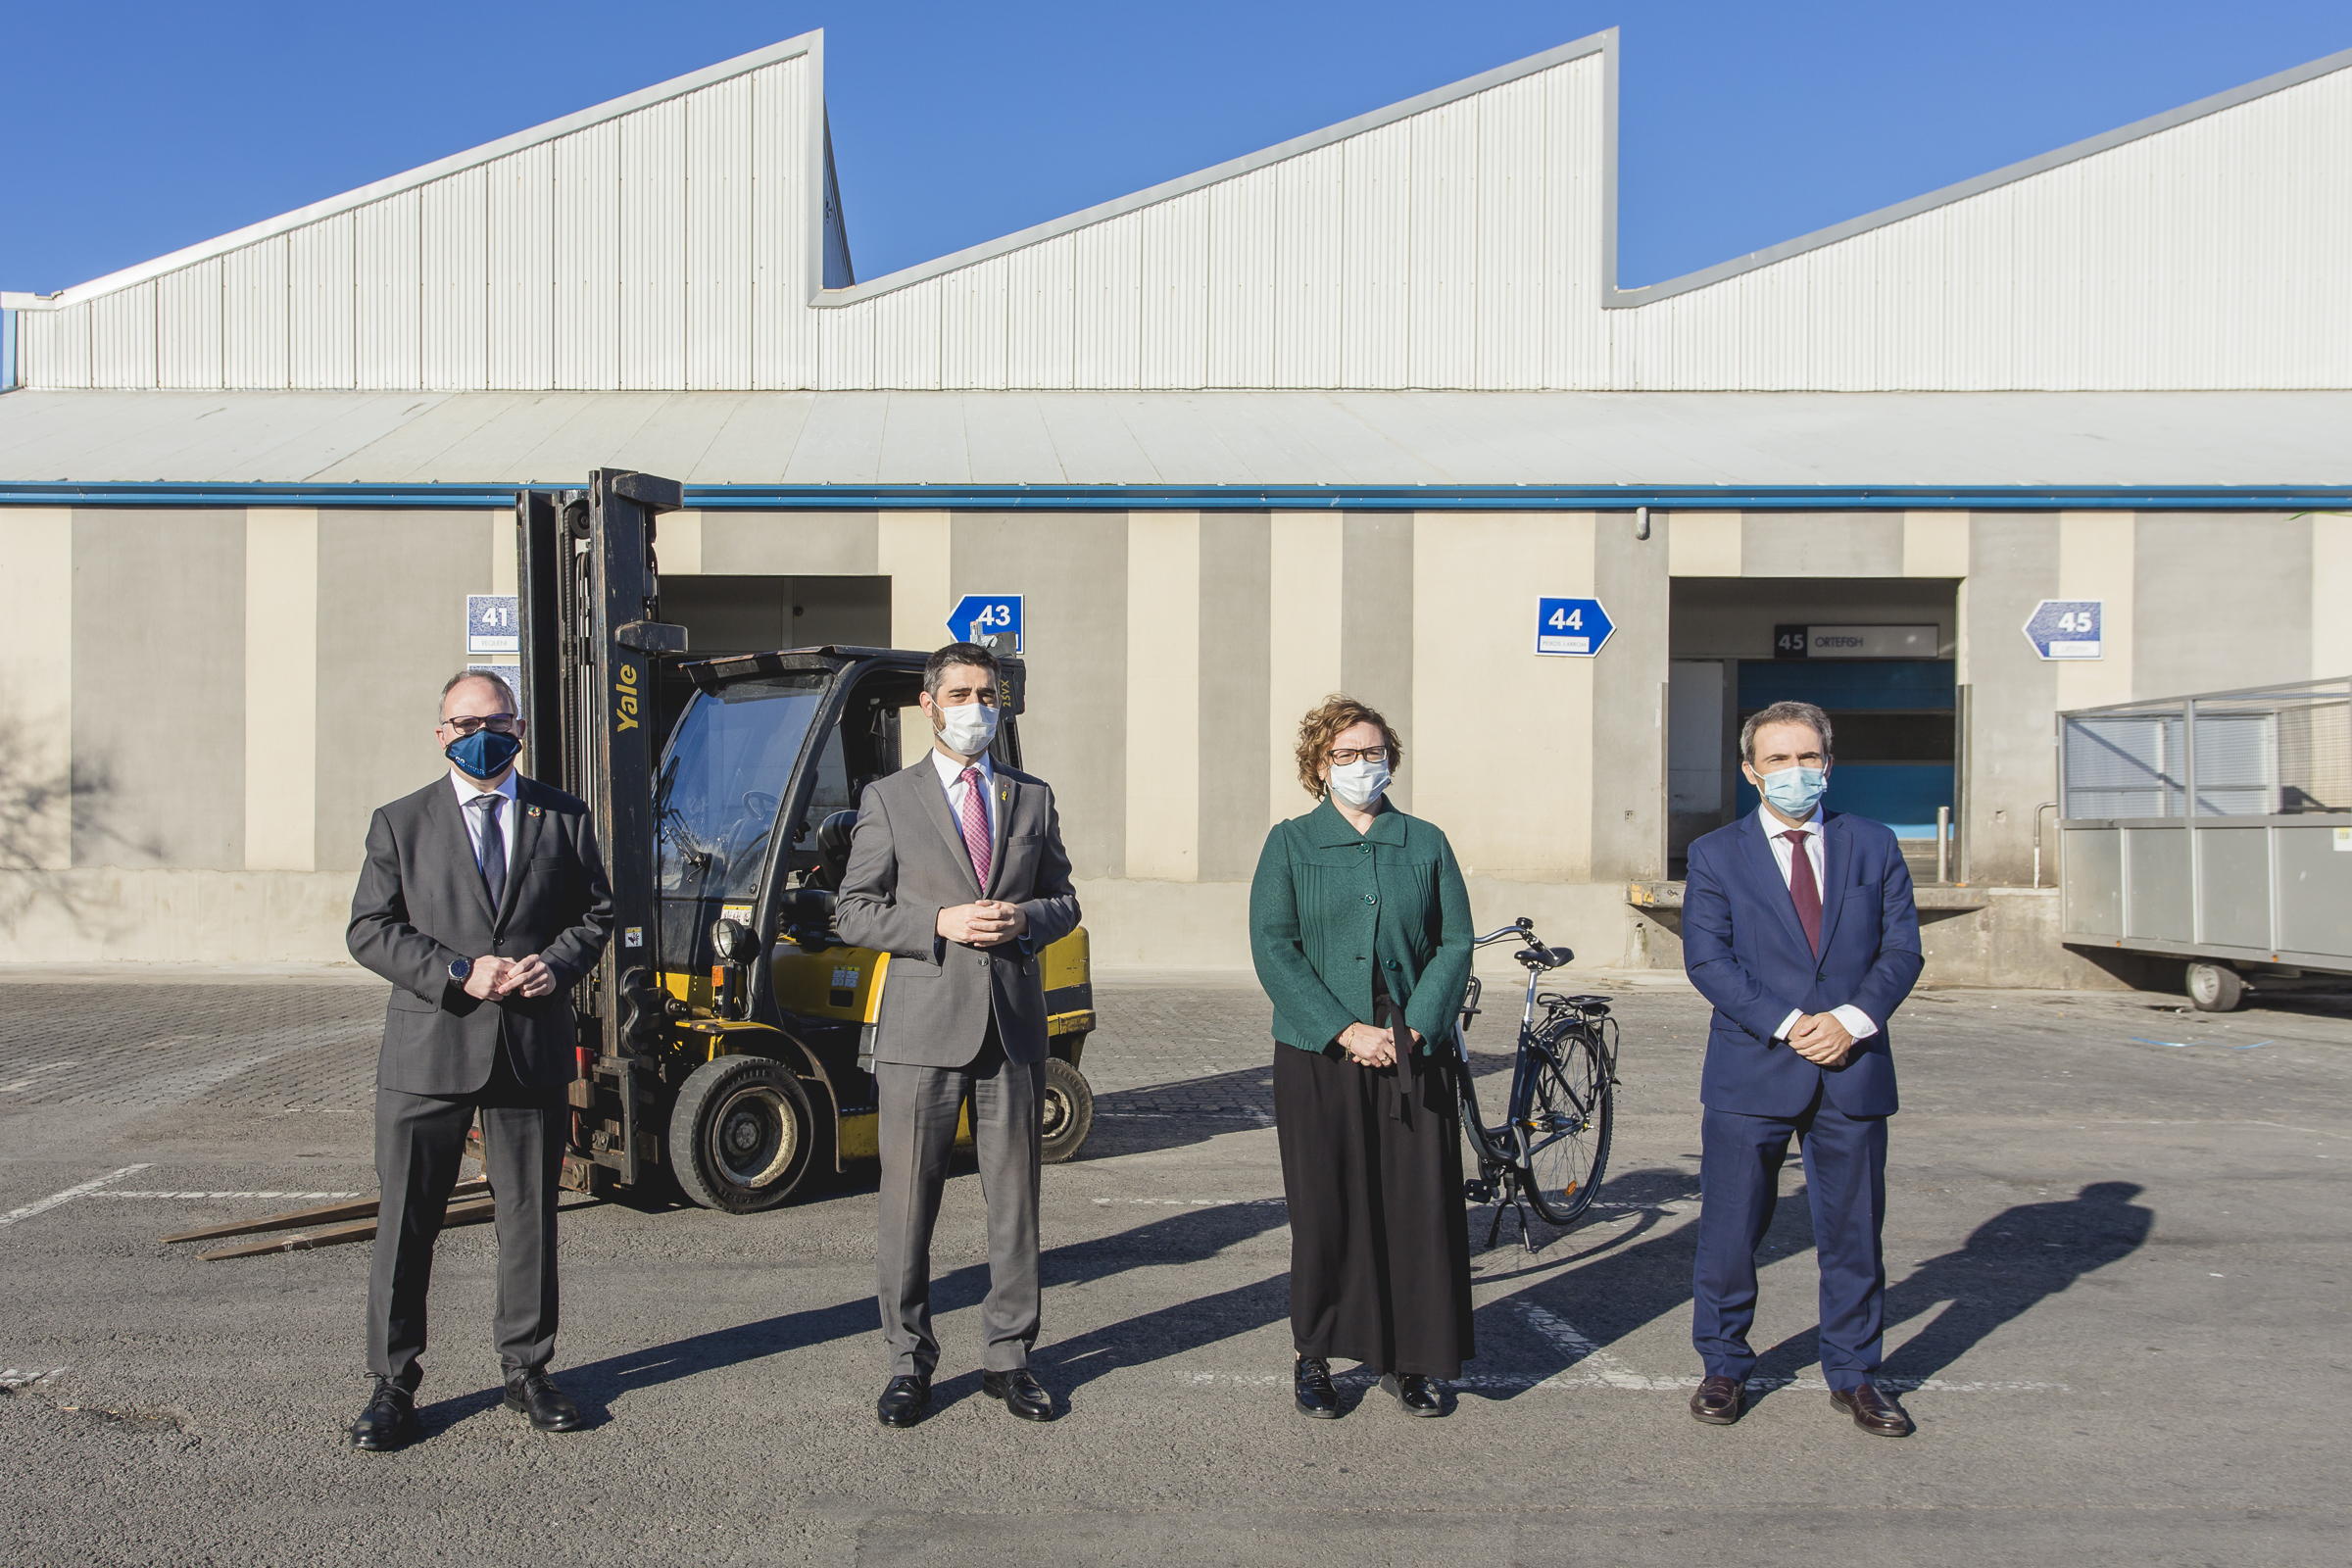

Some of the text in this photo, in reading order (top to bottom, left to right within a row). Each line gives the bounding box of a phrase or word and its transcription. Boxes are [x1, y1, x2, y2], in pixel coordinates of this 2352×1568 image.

[481, 607, 508, 627] 41
[977, 604, 1011, 626] 43
[1548, 608, 1584, 630] 44
[2058, 612, 2093, 633] 45
[1778, 633, 1864, 651] 45 ORTEFISH
[615, 663, 639, 733] Yale
[1001, 679, 1011, 708] 25VX
